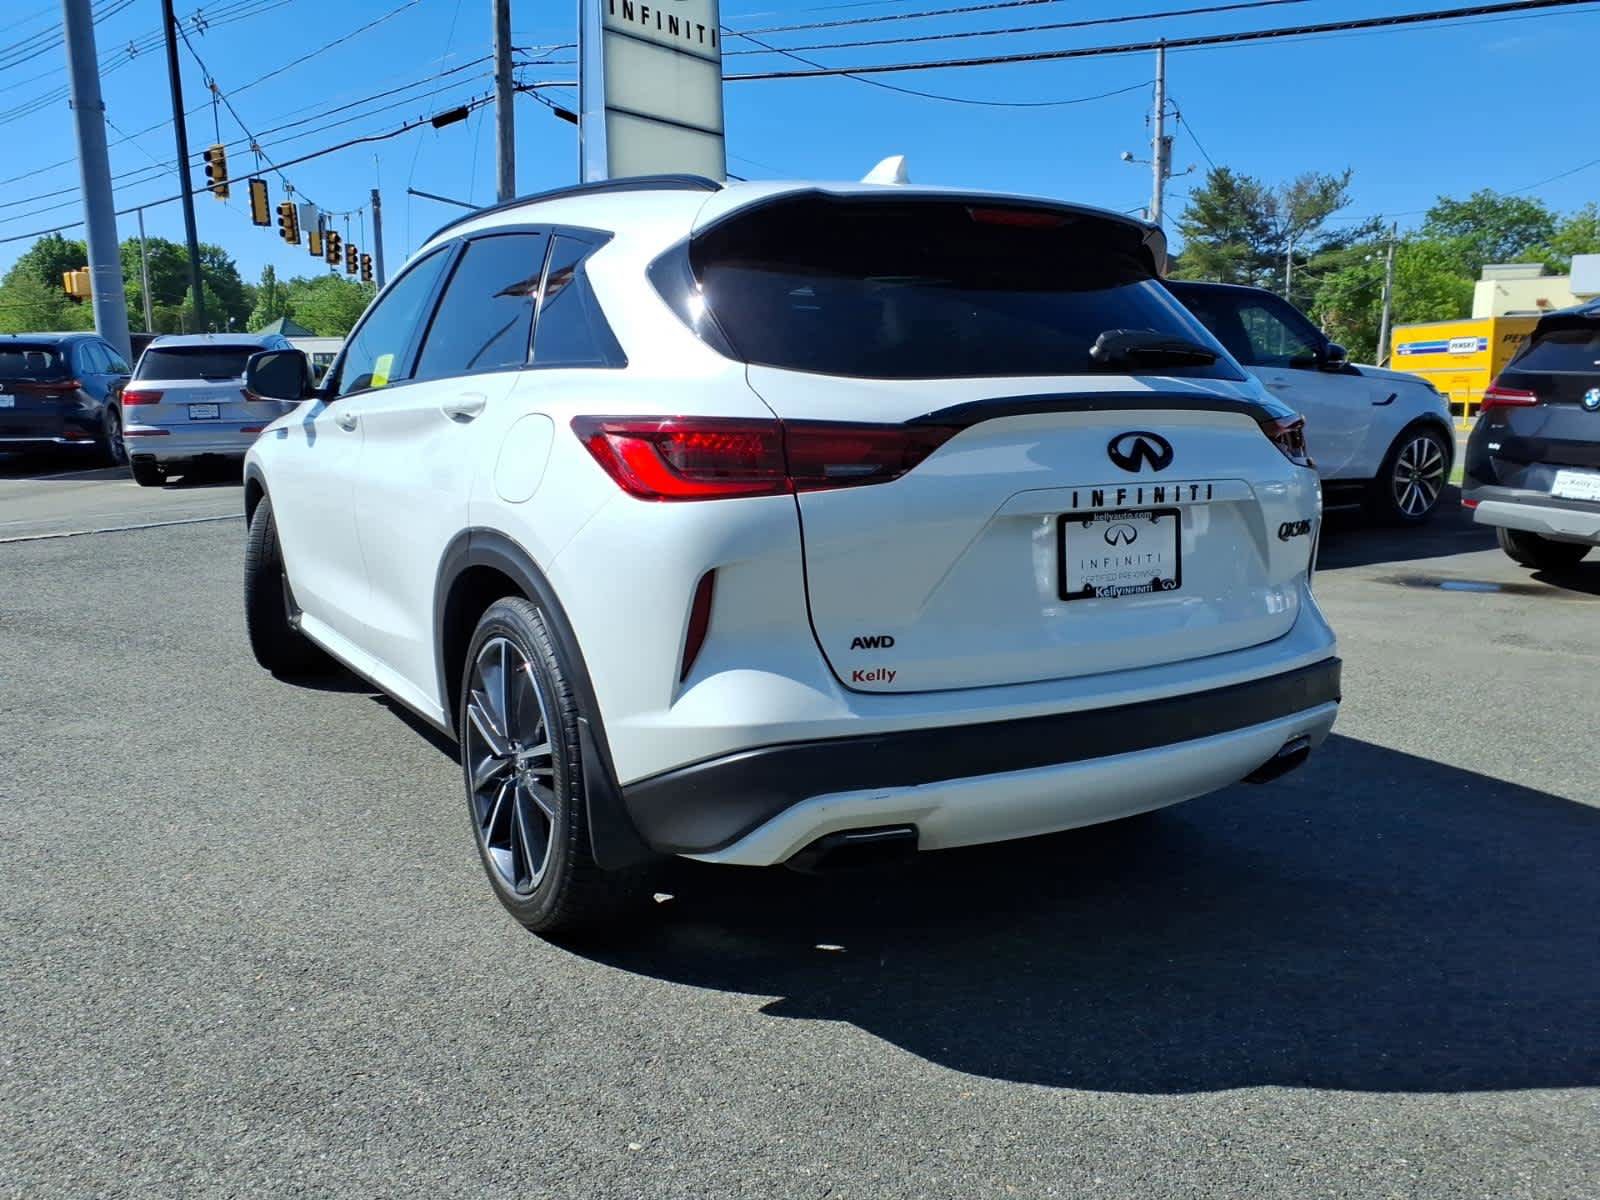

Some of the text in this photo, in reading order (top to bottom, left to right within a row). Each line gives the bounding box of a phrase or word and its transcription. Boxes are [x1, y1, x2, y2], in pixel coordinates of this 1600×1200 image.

[609, 0, 716, 48] INFINITI
[1072, 484, 1213, 509] INFINITI
[1080, 553, 1162, 569] INFINITI
[850, 634, 896, 650] AWD
[852, 667, 897, 683] Kelly
